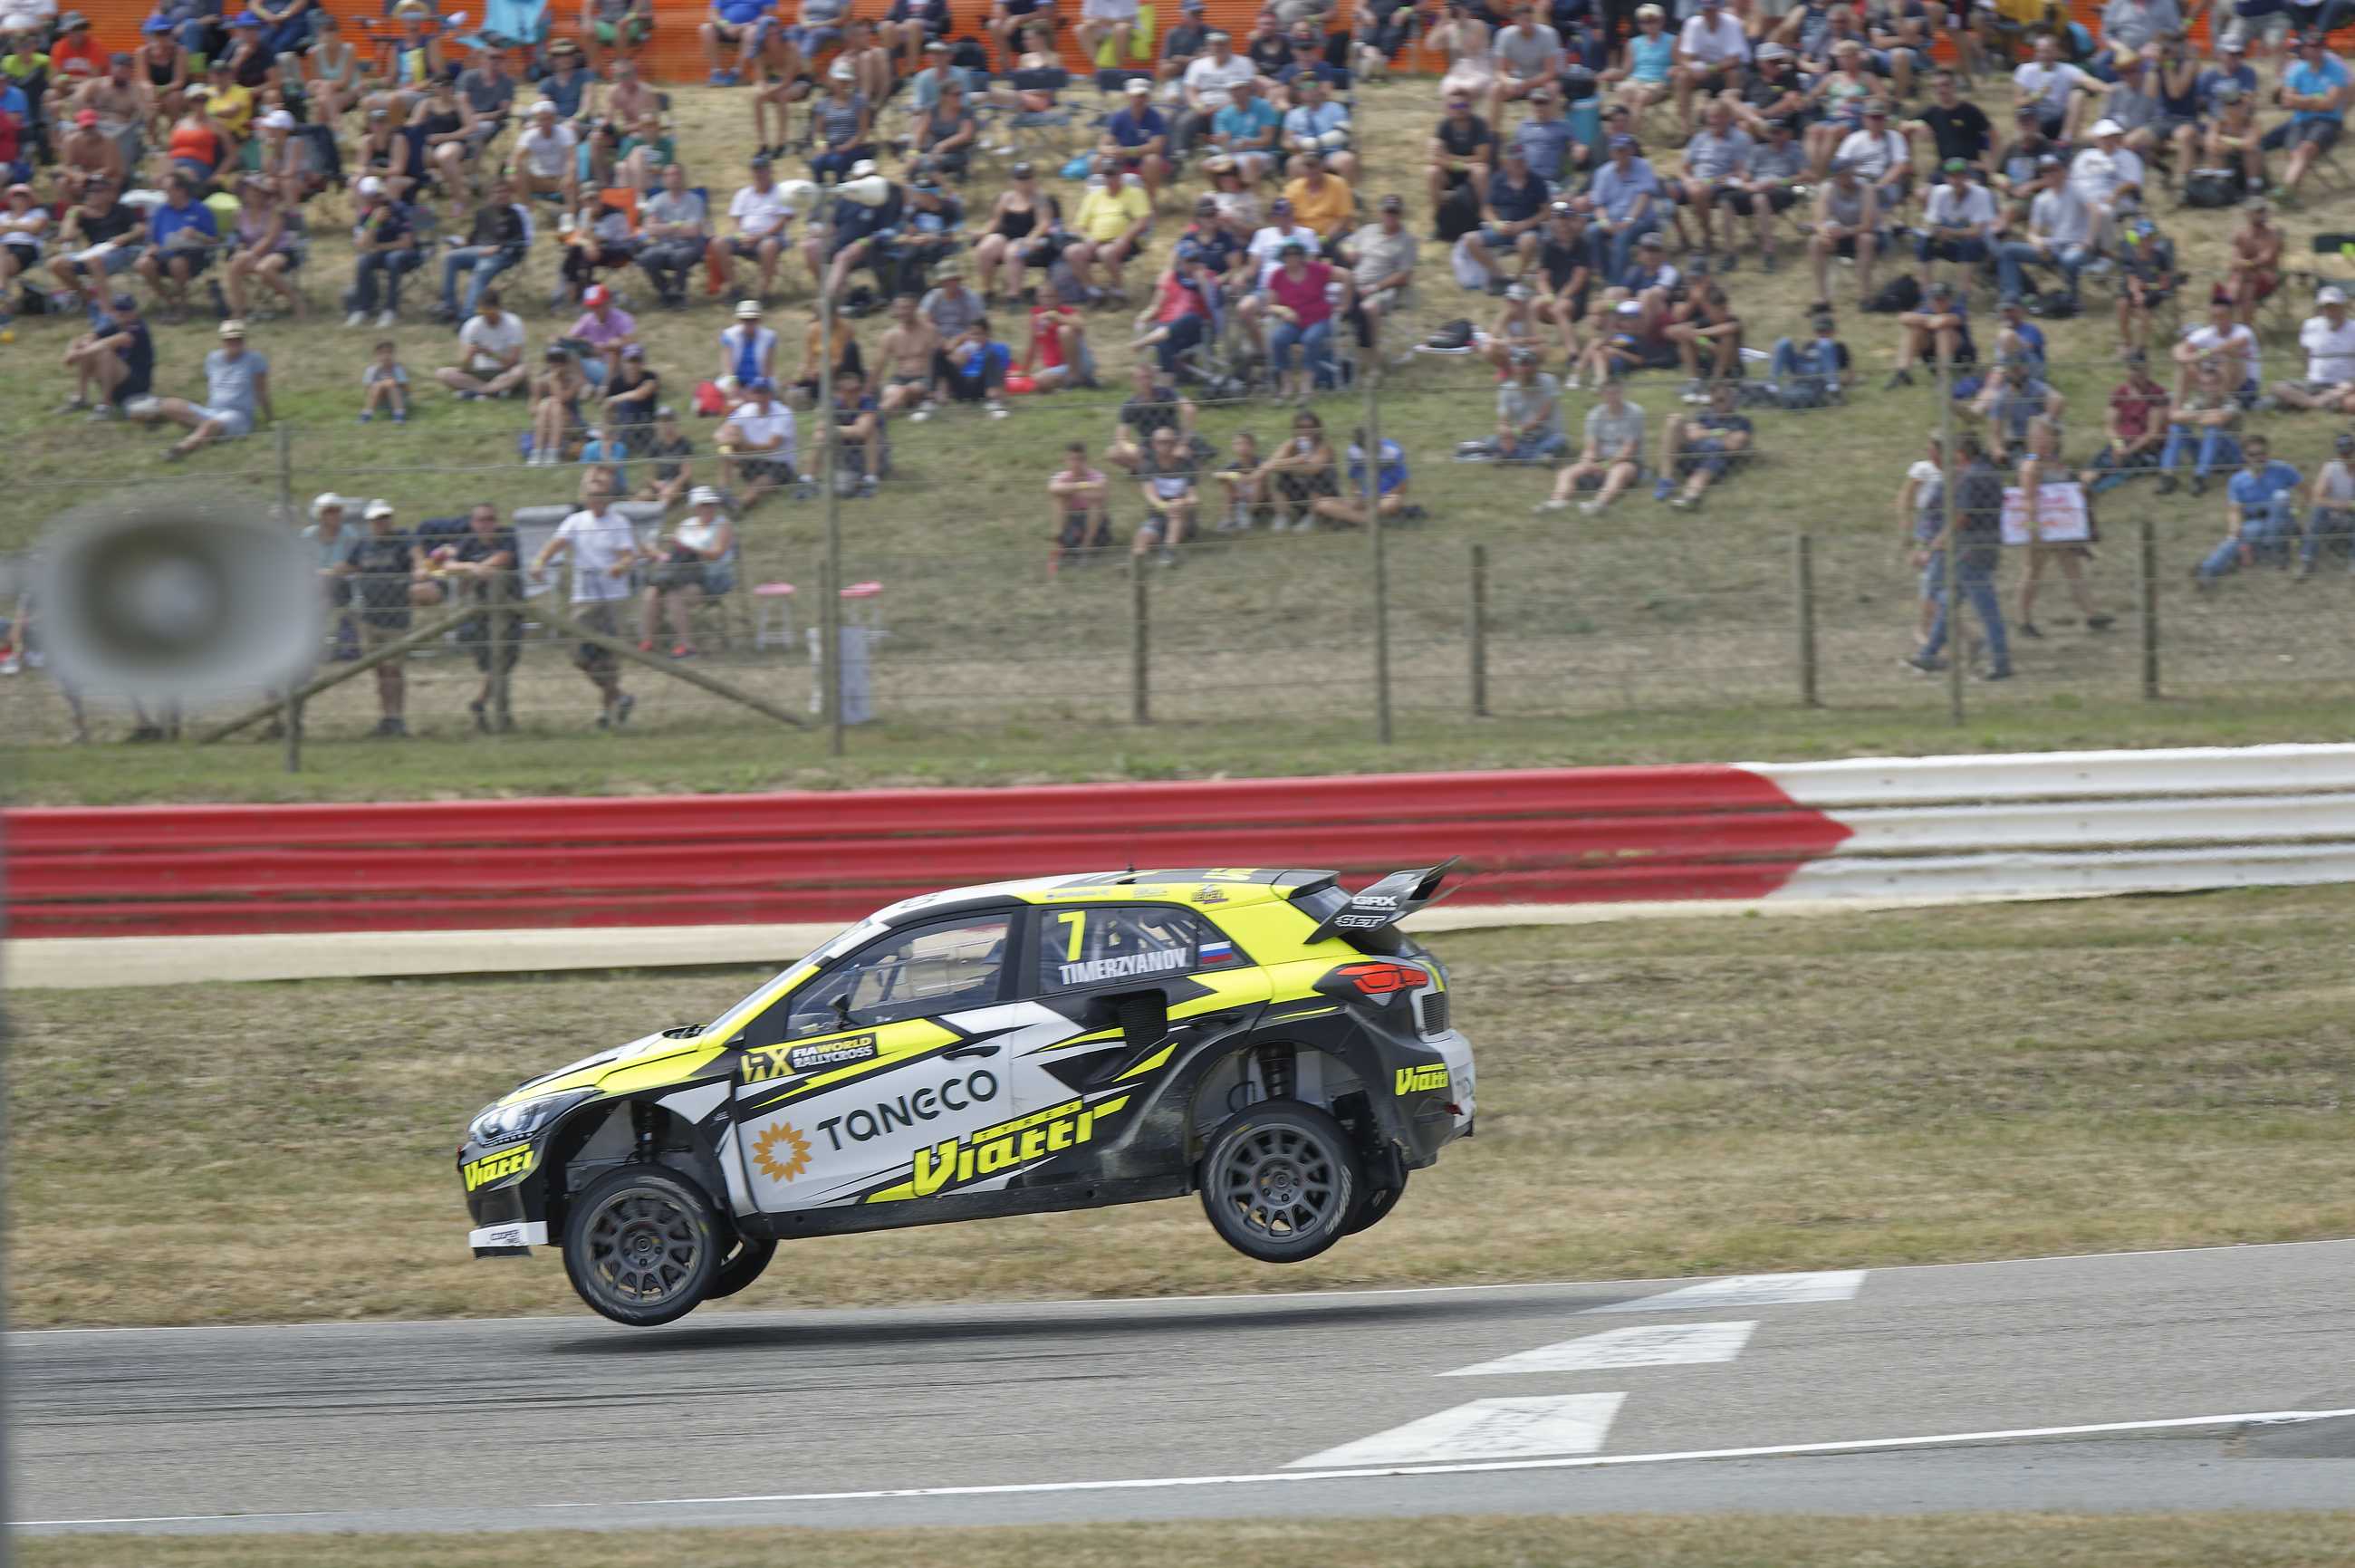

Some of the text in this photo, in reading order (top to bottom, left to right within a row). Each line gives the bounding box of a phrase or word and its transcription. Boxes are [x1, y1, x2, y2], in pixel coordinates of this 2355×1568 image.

[1351, 896, 1399, 906] GRX
[1058, 910, 1086, 962] 7
[1058, 948, 1187, 986] TIMERZYANOV
[793, 1046, 873, 1068] RALLYCROSS
[981, 1104, 1075, 1140] TYRES
[463, 1150, 534, 1192] Viatti
[913, 1111, 1094, 1197] Viatti
